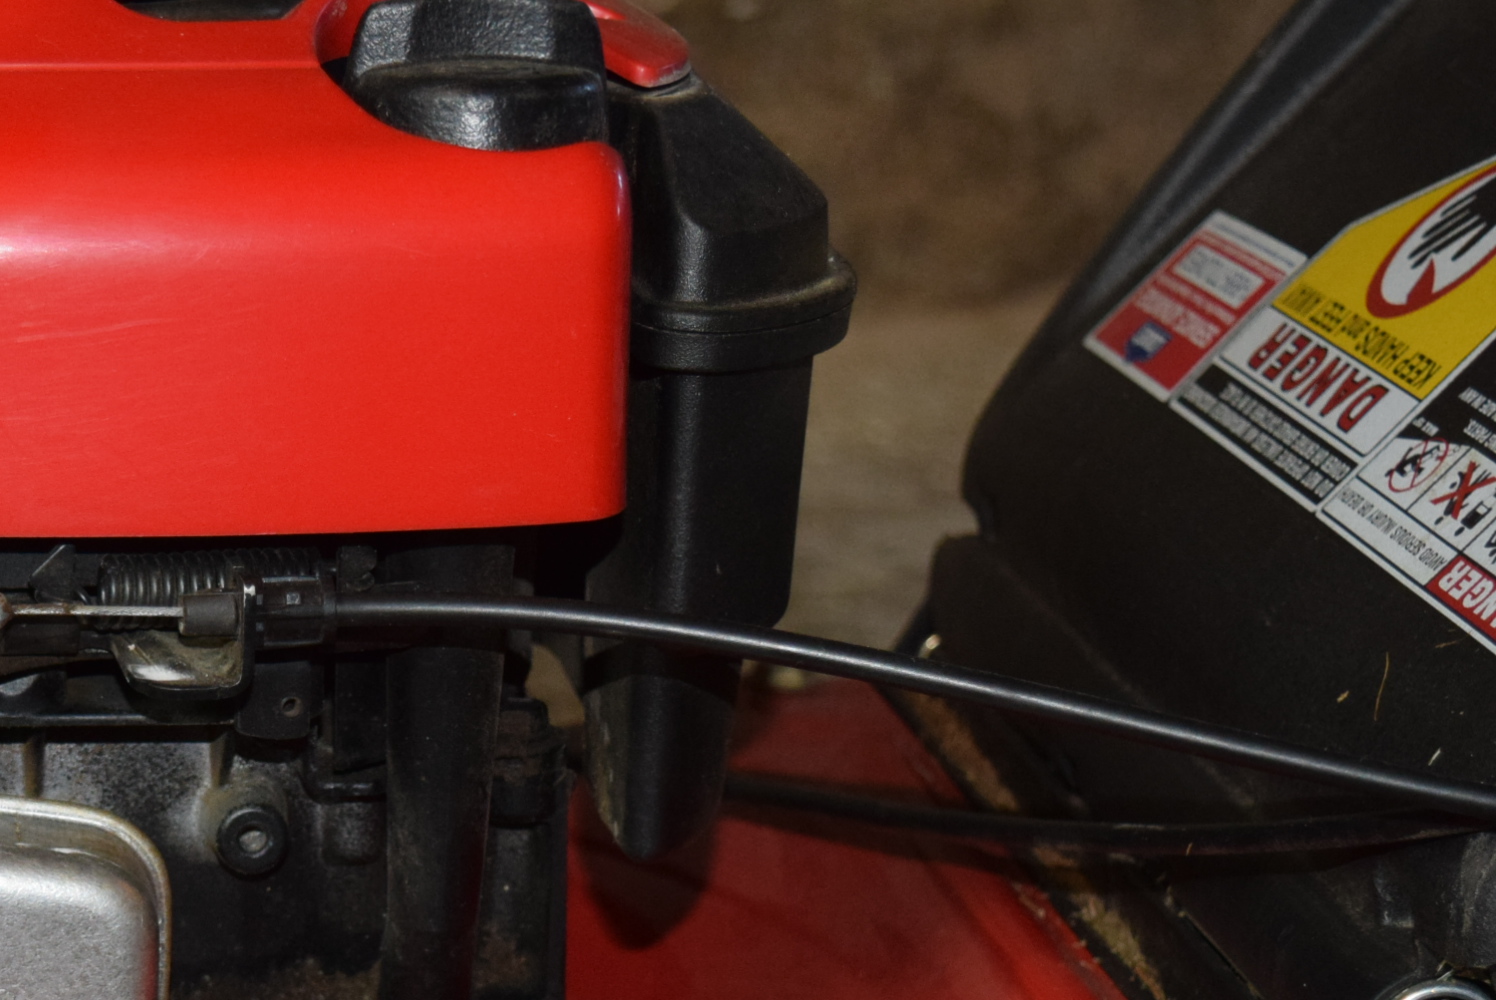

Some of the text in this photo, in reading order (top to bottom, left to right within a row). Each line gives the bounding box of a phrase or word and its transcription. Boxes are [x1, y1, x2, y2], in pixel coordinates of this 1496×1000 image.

[1247, 321, 1389, 433] DANGER
[1393, 352, 1442, 390] KEEP
[1389, 525, 1426, 556] SERIOUS
[1418, 547, 1448, 571] AVOID
[1438, 560, 1496, 628] NGER
